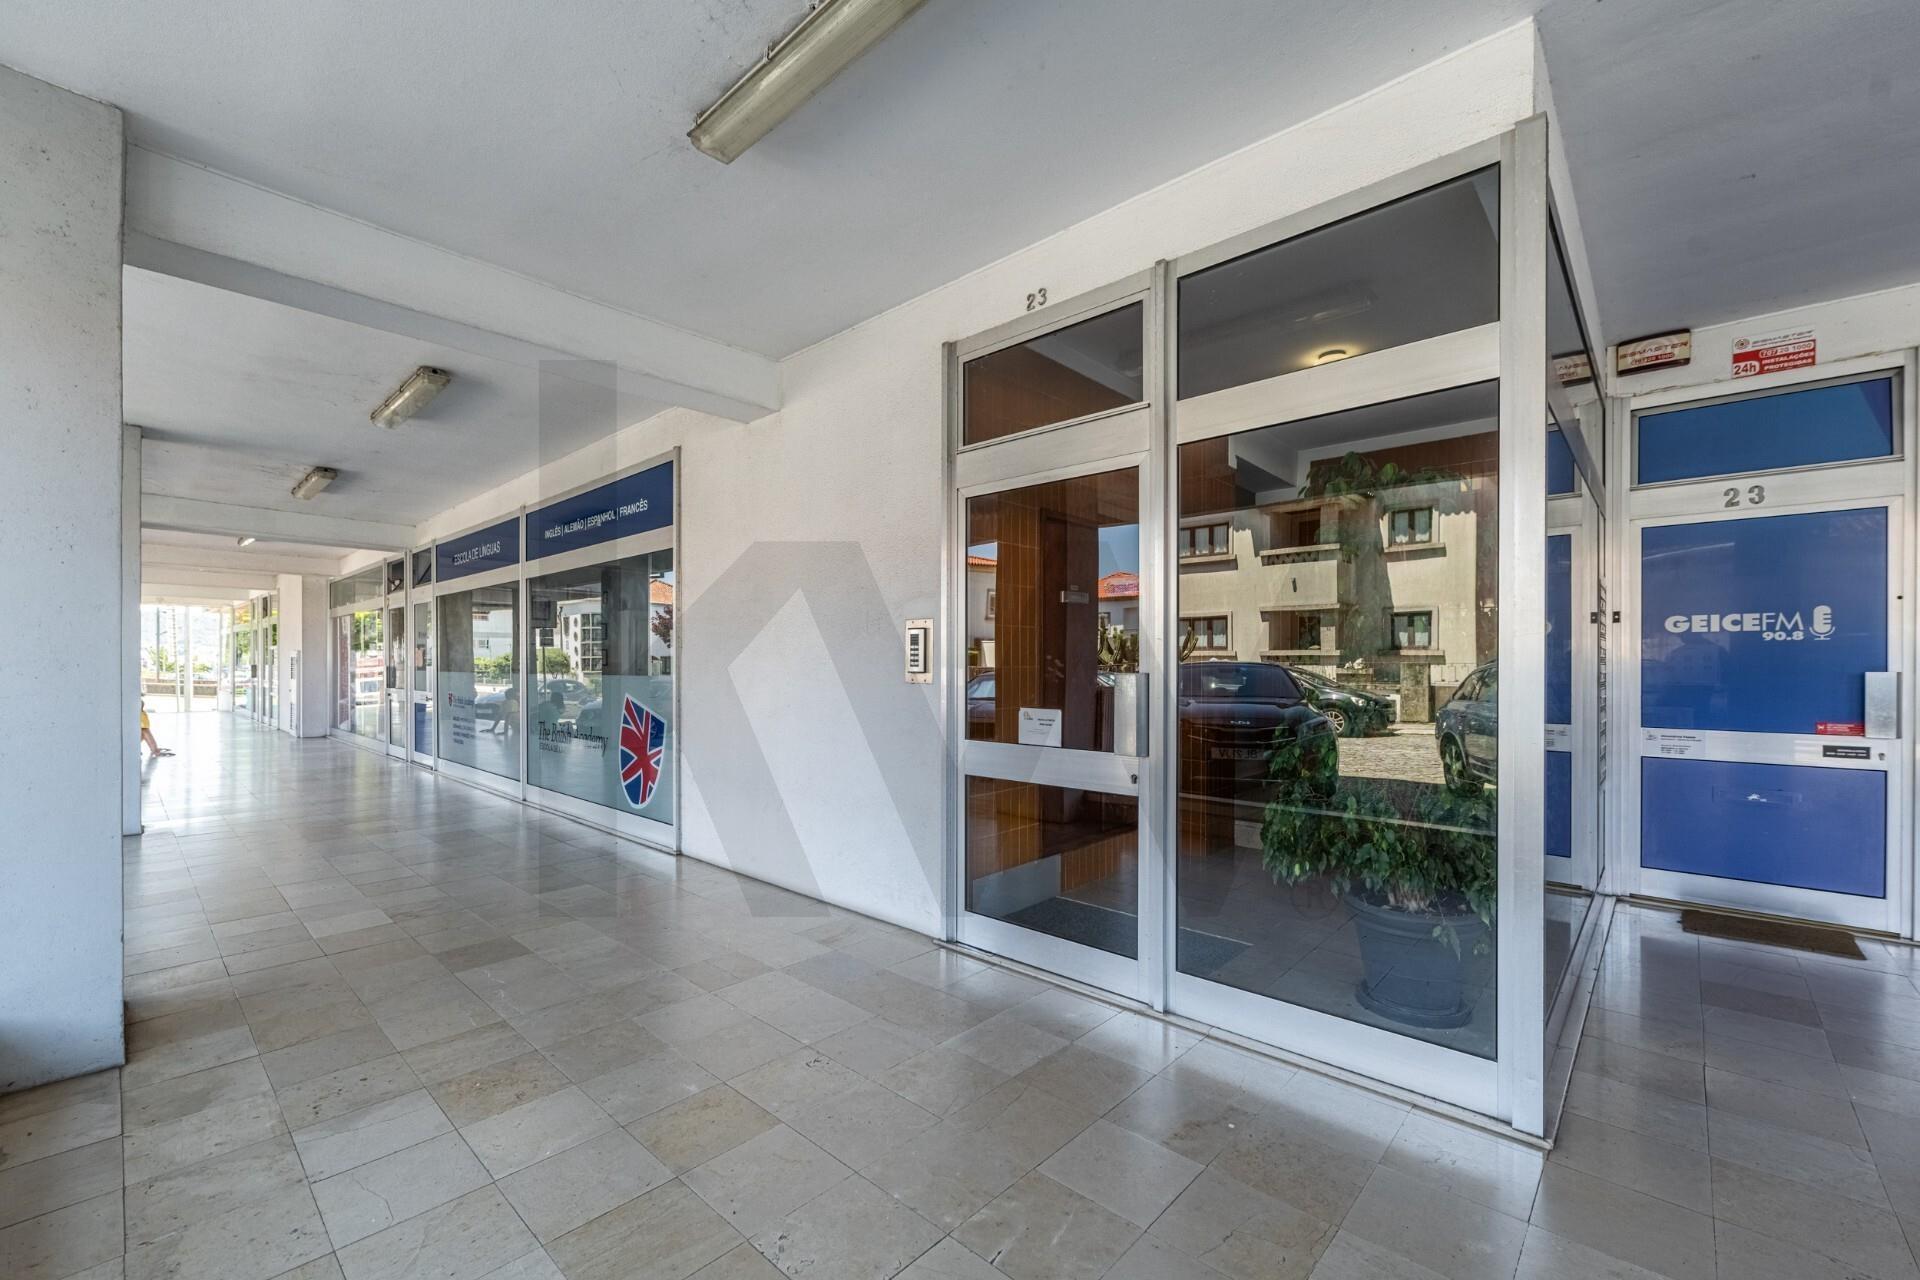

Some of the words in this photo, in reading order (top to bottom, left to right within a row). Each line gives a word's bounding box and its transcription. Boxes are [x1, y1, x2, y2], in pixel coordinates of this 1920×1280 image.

[1027, 287, 1047, 311] 23
[1734, 362, 1757, 376] 24h
[1723, 485, 1766, 508] 23
[545, 525, 562, 539] INGLÊS
[564, 518, 584, 534] ALEMÃO
[587, 509, 616, 528] ESPANHOL
[619, 498, 648, 518] FRANCÊS
[453, 550, 471, 566] ESCOLA
[471, 547, 479, 560] DE
[1762, 631, 1804, 641] 90.8
[538, 720, 550, 741] The
